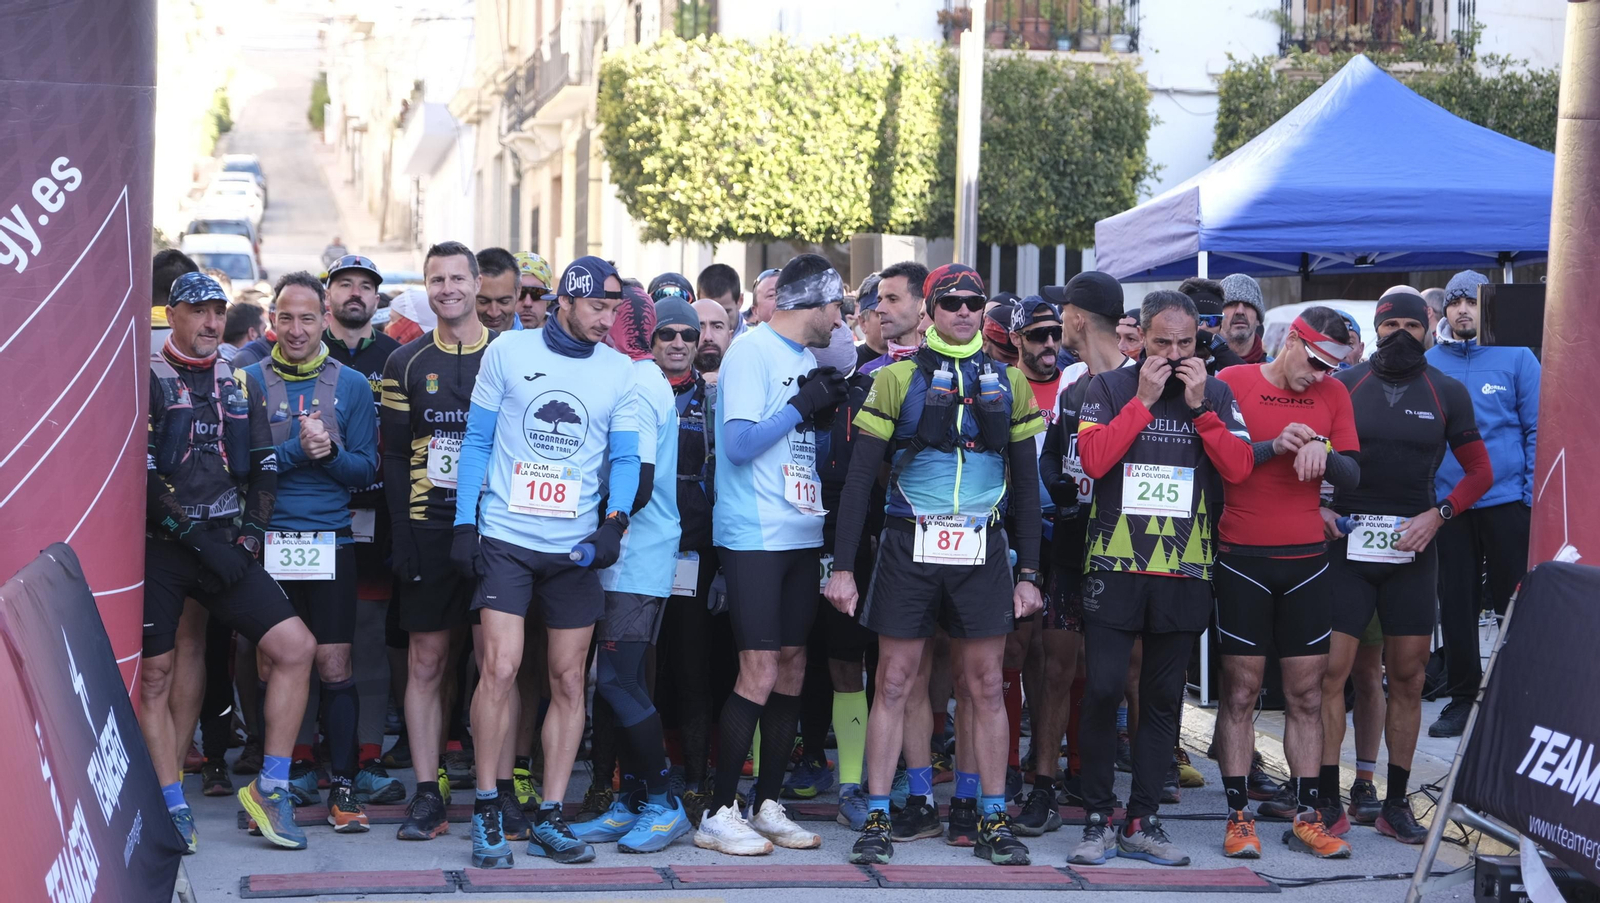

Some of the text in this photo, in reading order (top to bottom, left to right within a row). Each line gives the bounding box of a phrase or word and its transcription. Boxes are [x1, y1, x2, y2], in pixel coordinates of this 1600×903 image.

[1259, 394, 1315, 405] WONG
[1259, 401, 1315, 409] PERFORMANCE
[529, 432, 579, 447] LA CARRASCA
[533, 442, 572, 454] LORCA TRAIL
[1141, 435, 1191, 445] STONE 1958
[439, 454, 459, 474] 3
[532, 463, 549, 471] CxM
[526, 480, 566, 503] 108
[794, 481, 817, 504] 113
[1136, 481, 1178, 503] 245
[937, 530, 965, 551] 87
[1361, 530, 1401, 550] 238
[279, 547, 321, 567] 332
